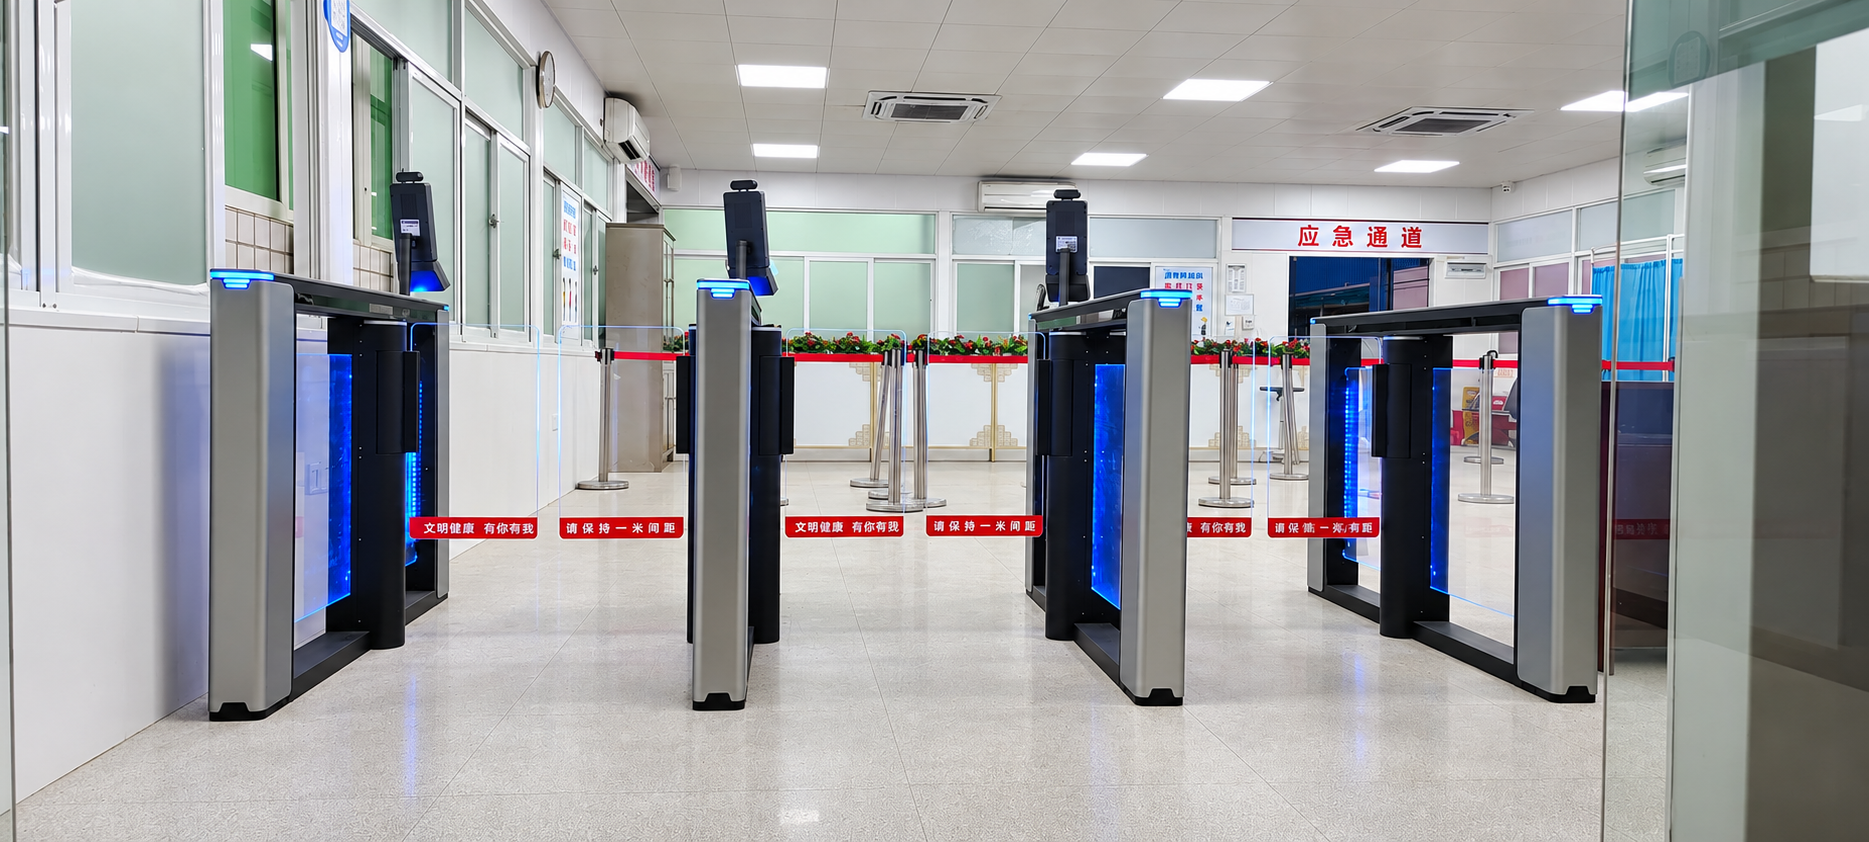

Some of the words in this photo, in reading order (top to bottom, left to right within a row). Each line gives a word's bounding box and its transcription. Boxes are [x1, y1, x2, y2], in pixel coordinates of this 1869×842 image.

[1298, 224, 1422, 248] 应急通道
[424, 522, 475, 534] 文明健康
[484, 522, 534, 534] 有你有我
[566, 522, 676, 534] 请保持一米间距
[795, 520, 844, 533] 文明健康
[852, 520, 900, 533] 有你有我
[933, 520, 1036, 532] 请保持一米间距
[1200, 521, 1247, 533] 有你有我
